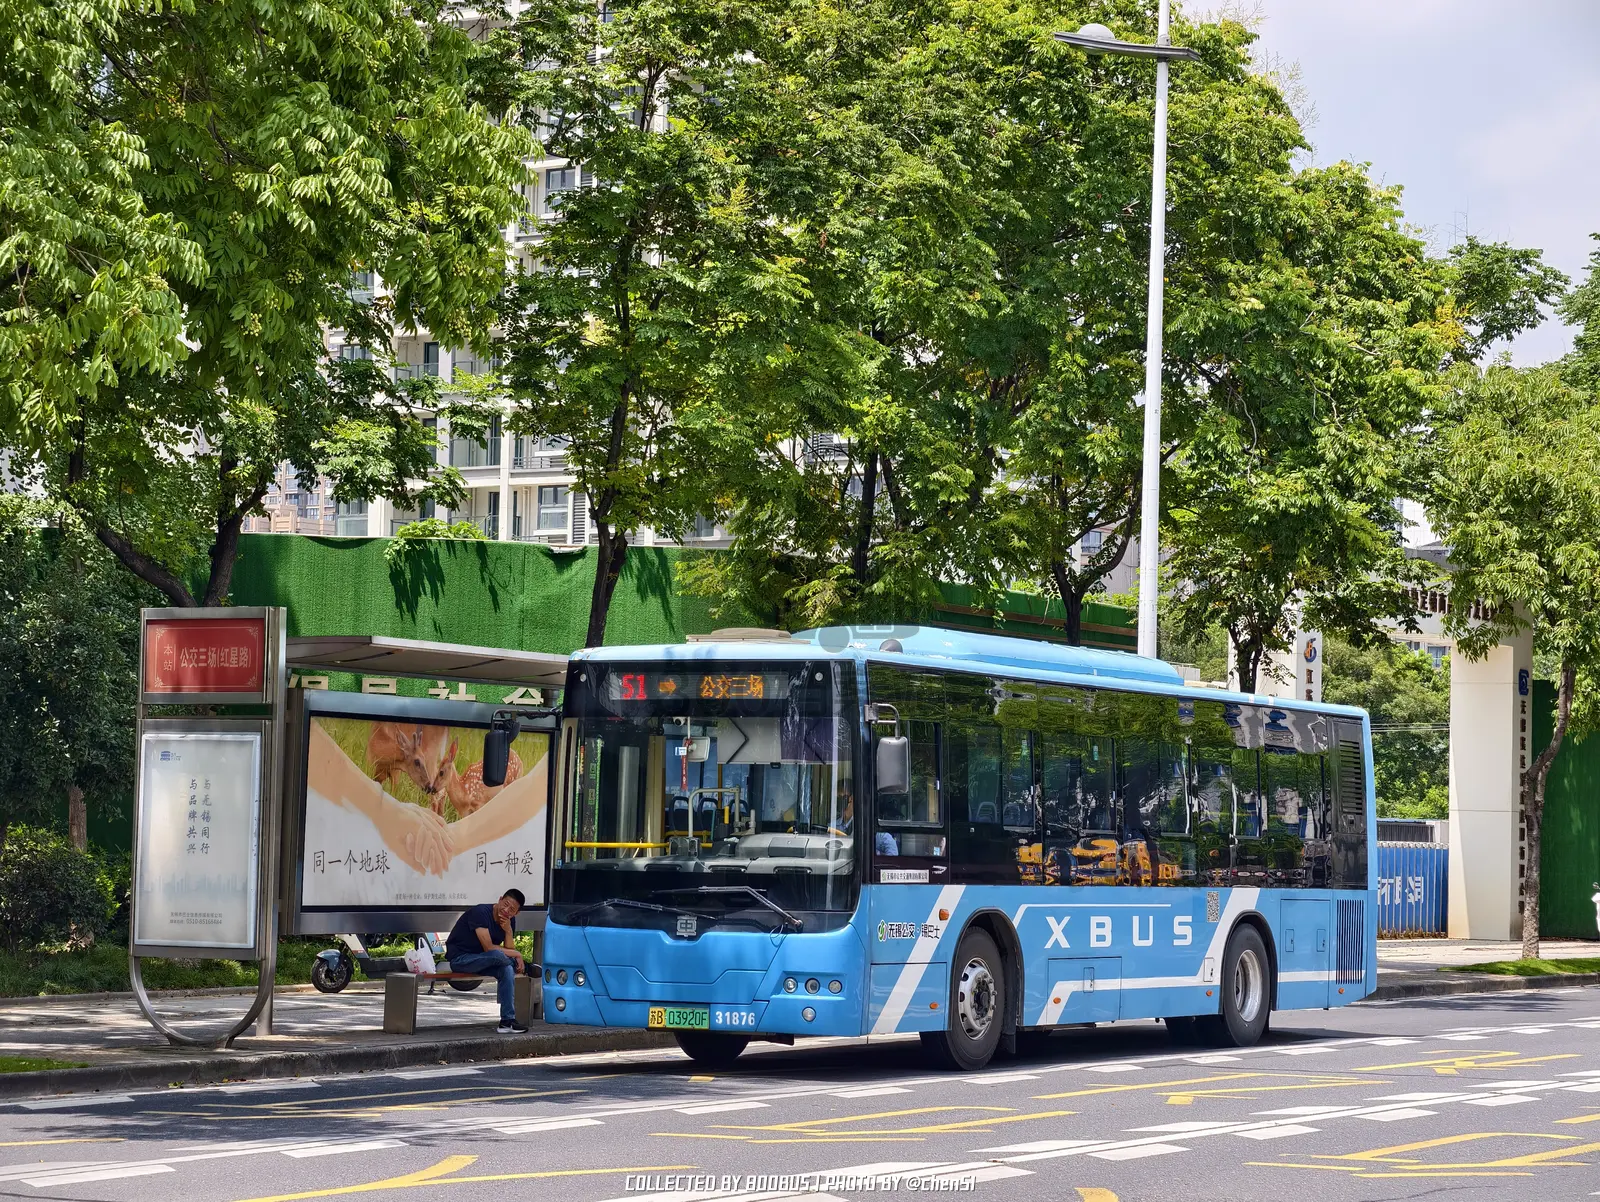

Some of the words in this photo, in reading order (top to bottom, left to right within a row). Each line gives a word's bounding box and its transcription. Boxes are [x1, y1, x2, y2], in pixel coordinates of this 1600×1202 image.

[180, 646, 252, 669] 公交三场(红星路)
[621, 674, 647, 700] 51
[700, 674, 764, 699] 公交三场
[313, 849, 391, 875] 同一个地球
[476, 850, 534, 875] 同一种爱
[715, 1011, 755, 1026] 31876
